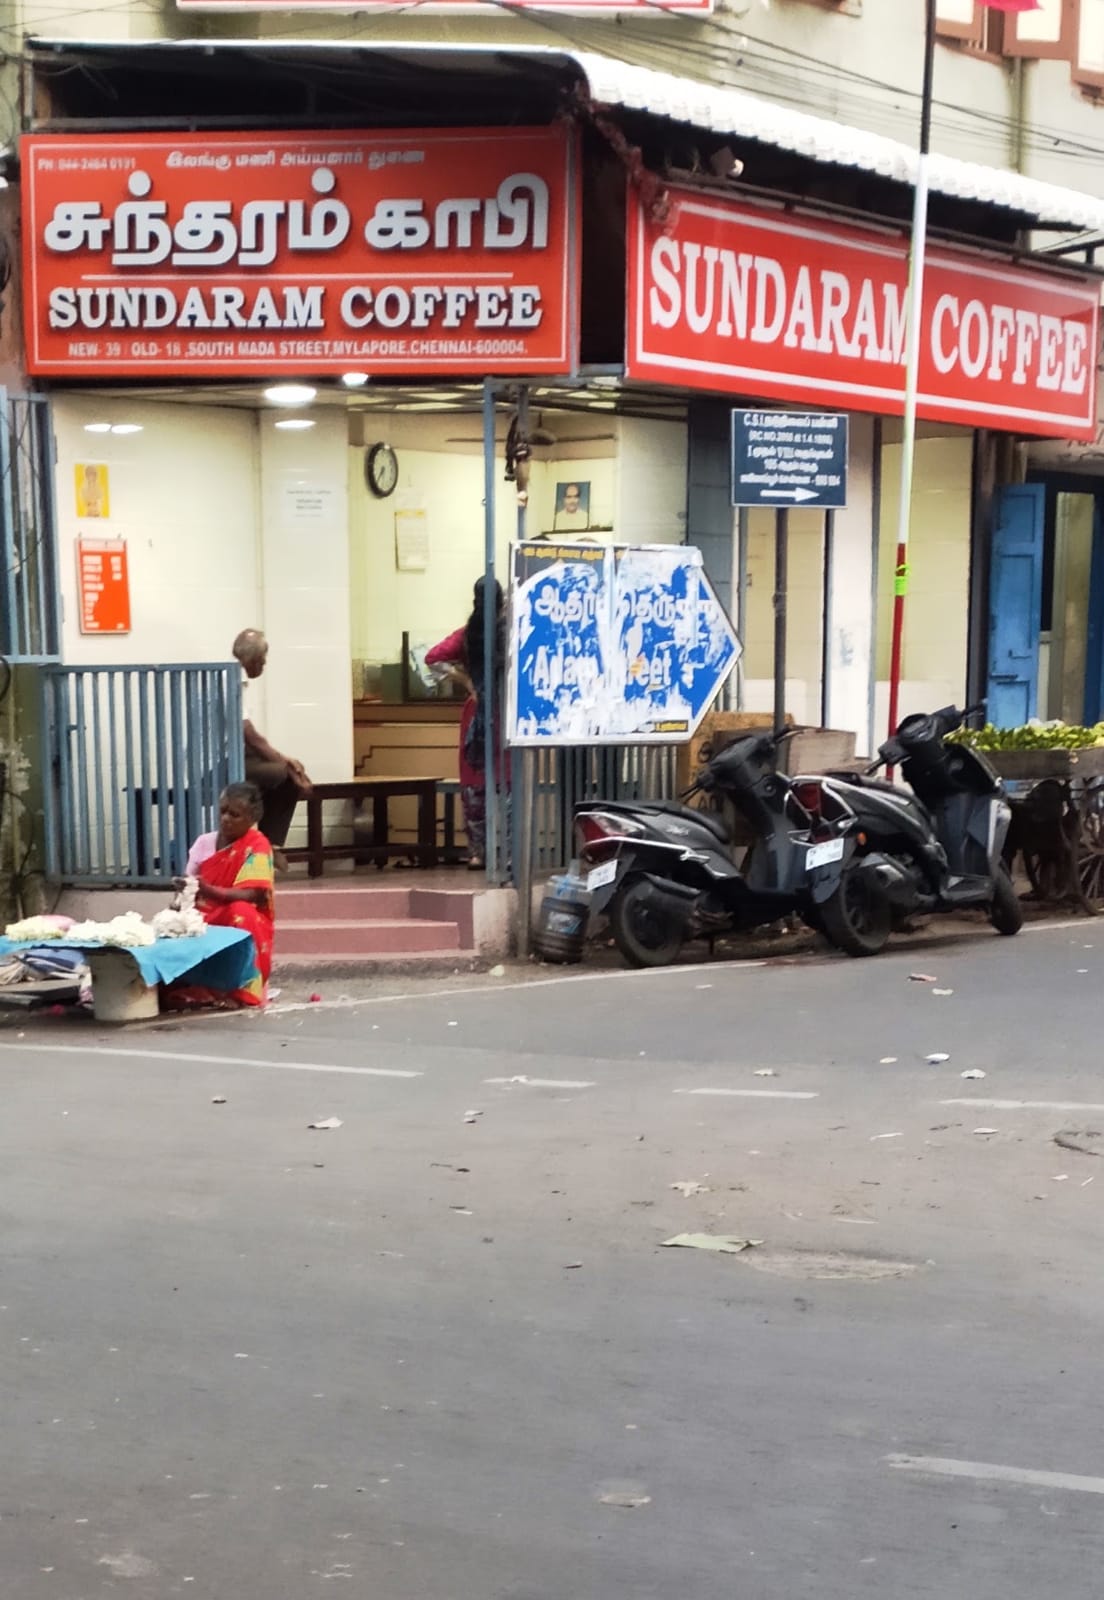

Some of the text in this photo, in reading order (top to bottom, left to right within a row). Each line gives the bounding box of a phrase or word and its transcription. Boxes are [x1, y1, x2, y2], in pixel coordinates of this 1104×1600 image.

[44, 167, 550, 266] சுந்தரம் காபி
[49, 285, 543, 328] SUNDARAM COFFEE
[650, 235, 1087, 395] SUNDARAM COFFEE
